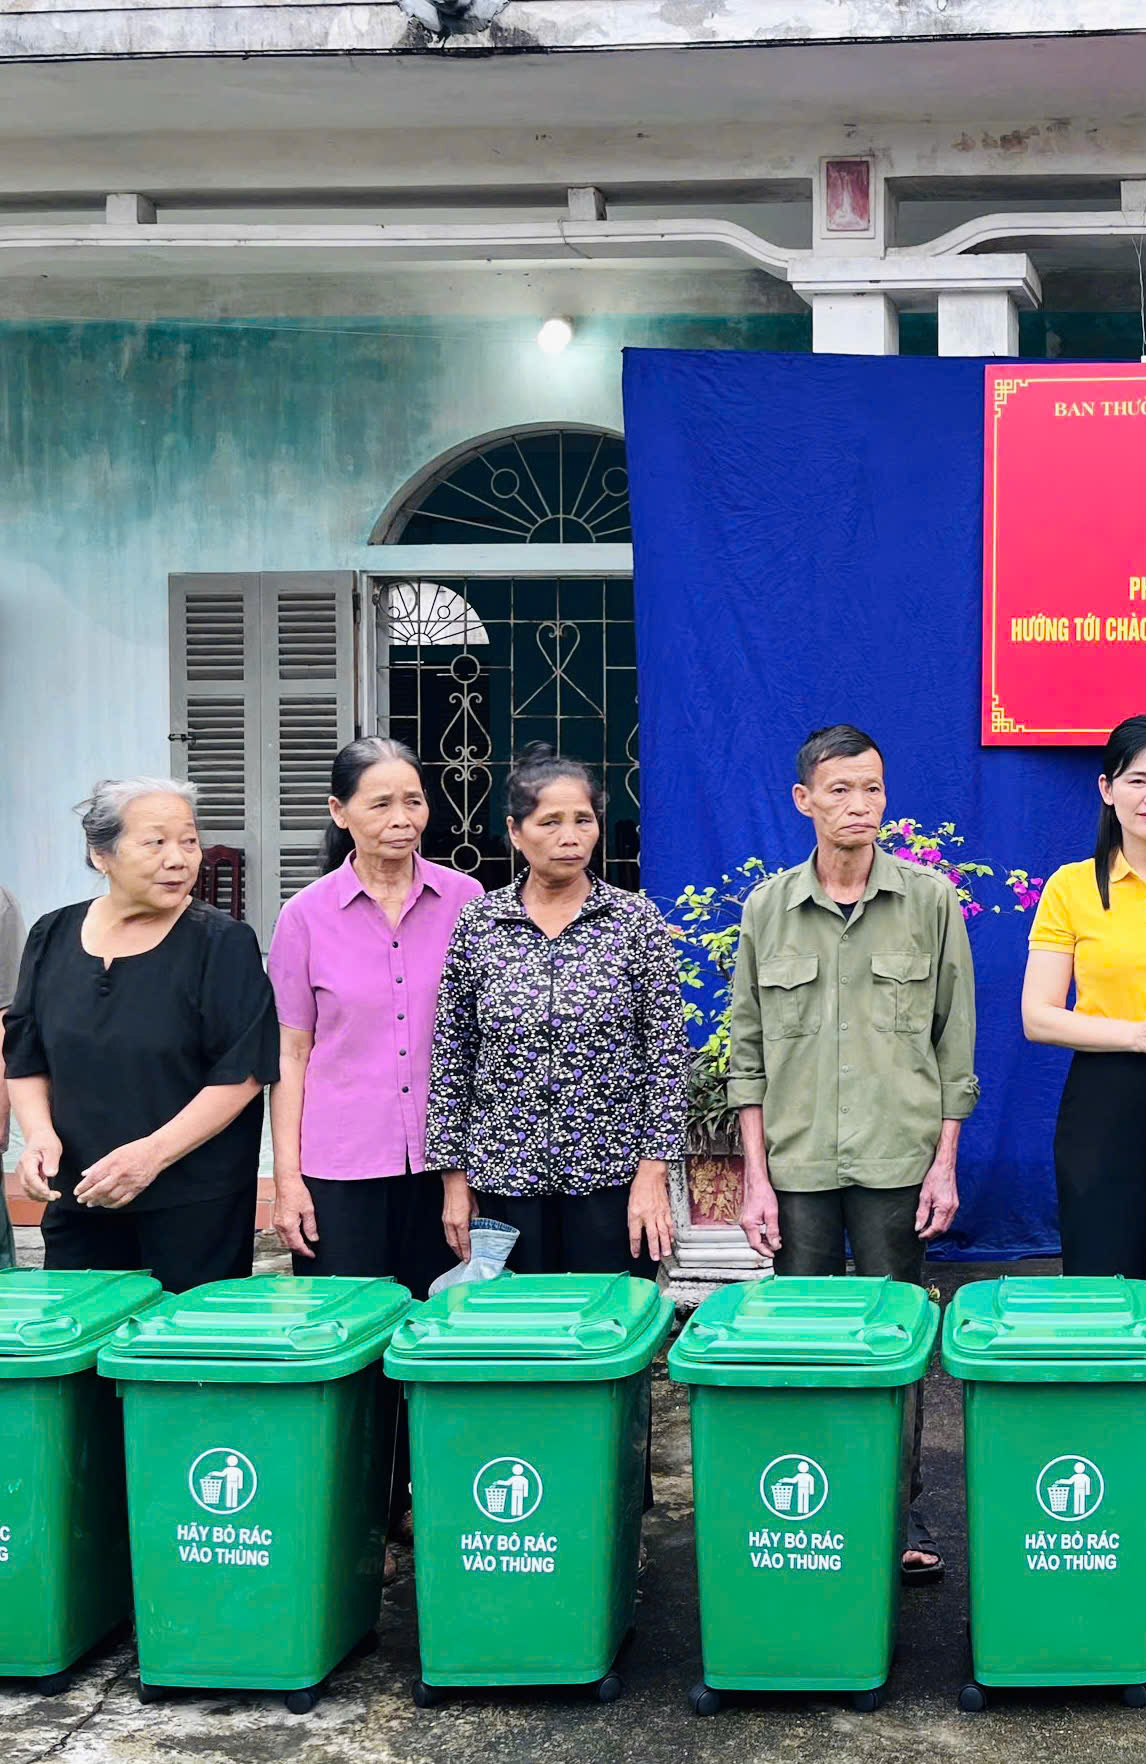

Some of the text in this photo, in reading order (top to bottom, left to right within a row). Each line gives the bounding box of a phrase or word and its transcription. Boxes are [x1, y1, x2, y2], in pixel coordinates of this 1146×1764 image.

[1055, 402, 1094, 416] BAN
[1012, 612, 1069, 642] HƯỚNG
[1074, 612, 1100, 641] TỚI
[178, 1522, 272, 1545] HÃY BỎ RÁC
[462, 1531, 557, 1552] HÃY BỎ RÁC
[750, 1529, 843, 1551] HÃY BỎ RÁC
[1026, 1530, 1119, 1549] HÃY BỎ RÁC
[179, 1545, 269, 1566] VÀO THÙNG
[463, 1552, 554, 1572] VÀO THÙNG
[751, 1551, 841, 1570] VÀO THÙNG
[1027, 1551, 1116, 1570] VÀO THÙNG
